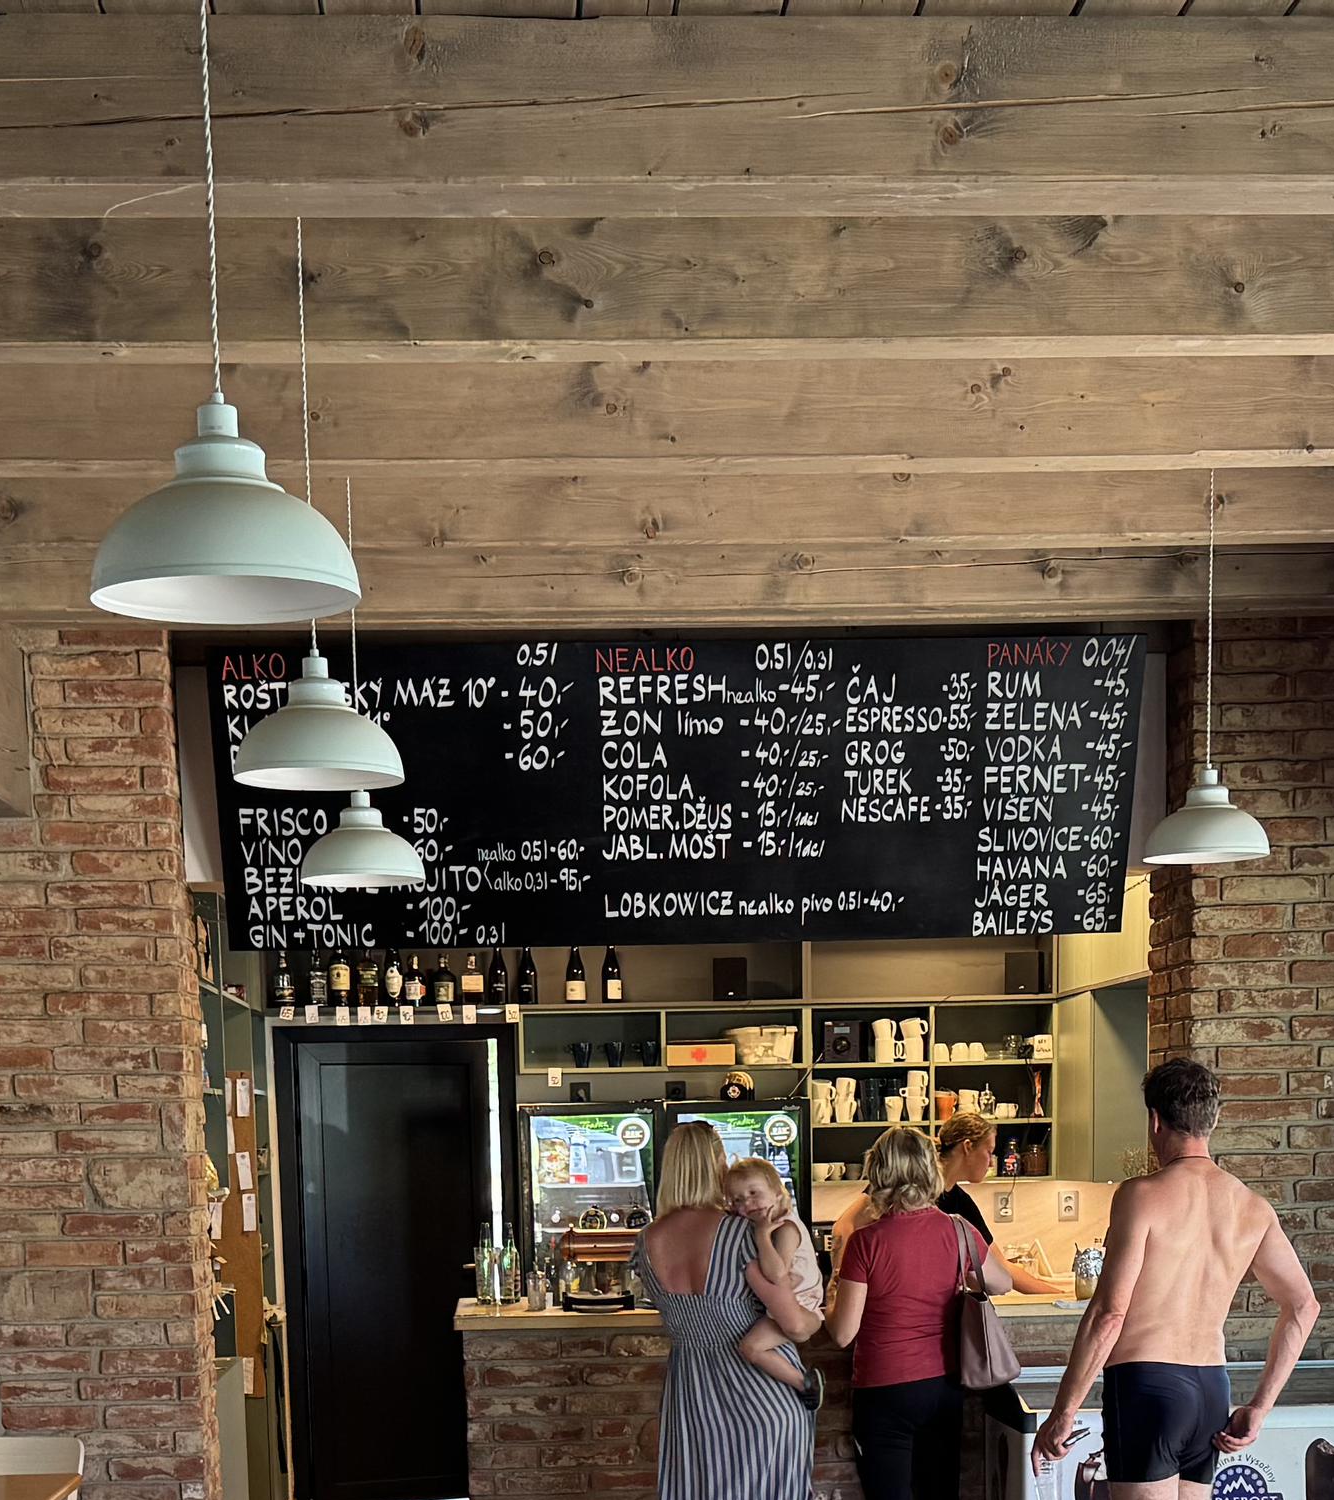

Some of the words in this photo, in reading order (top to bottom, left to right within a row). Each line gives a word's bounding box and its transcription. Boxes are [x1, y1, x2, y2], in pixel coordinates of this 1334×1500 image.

[222, 652, 286, 681] ALKO
[595, 646, 696, 673] NEALKO
[987, 636, 1073, 668] PANÁKY
[223, 678, 383, 711] ROŠTSKÝ
[598, 674, 726, 706] REFRESH
[727, 677, 776, 704] nealko
[846, 663, 895, 705] ČAJ
[987, 671, 1042, 699] RUM
[600, 709, 662, 737] ZON
[845, 705, 943, 733] ESPRESSO
[984, 700, 1089, 732] ZELENÁ
[601, 740, 667, 769] COLA
[845, 739, 906, 766] GROG
[985, 734, 1062, 763] VODKA
[603, 774, 694, 801] KOFOLA
[843, 767, 913, 796] TUREK
[983, 763, 1087, 795] FERNET
[238, 807, 328, 837] FRISCO
[841, 796, 931, 823] NESCAFE
[983, 794, 1053, 823] VIŠEŇ
[240, 837, 303, 866] VÍNO
[669, 830, 732, 860] MOŠT
[977, 826, 1083, 853] SLIVOVICE
[494, 871, 522, 892] alko
[977, 855, 1067, 881] HAVANA
[248, 895, 343, 921] APEROL
[604, 890, 733, 918] LOBKOWICZ
[739, 893, 794, 916] nealko
[802, 893, 832, 925] pivo
[249, 924, 287, 949] GIN
[972, 909, 1053, 937] BAILEYS
[1245, 1453, 1276, 1483] Vysočiny
